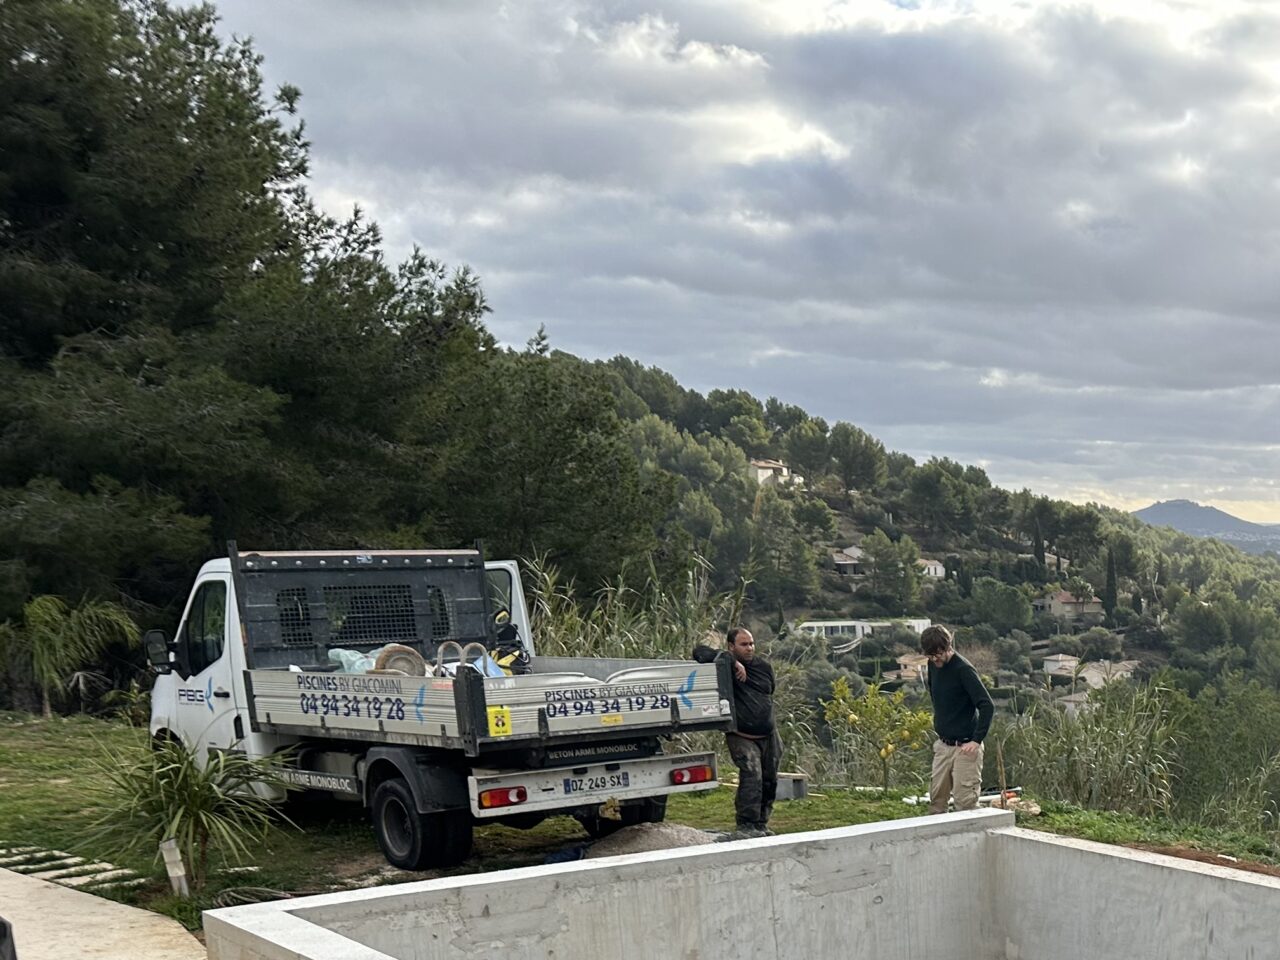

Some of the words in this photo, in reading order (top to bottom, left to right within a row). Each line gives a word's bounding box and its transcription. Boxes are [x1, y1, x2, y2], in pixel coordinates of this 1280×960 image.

[297, 675, 338, 691] PISCINES
[339, 677, 350, 691] BY
[352, 678, 402, 694] GIACOMINI
[545, 688, 596, 701] PISCINES
[600, 687, 612, 698] BY
[615, 683, 670, 695] GIACOMINI
[178, 689, 205, 702] PBG
[301, 693, 318, 714] 04
[321, 694, 339, 716] 94
[342, 695, 360, 717] 34
[363, 696, 383, 719] 19
[385, 697, 405, 720] 28
[546, 703, 568, 717] 04
[573, 701, 595, 715] 94
[600, 699, 621, 713] 34
[626, 697, 645, 711] 19
[650, 695, 670, 709] 28
[597, 744, 638, 754] MONOBLOC
[310, 775, 351, 791] MONOBLOC
